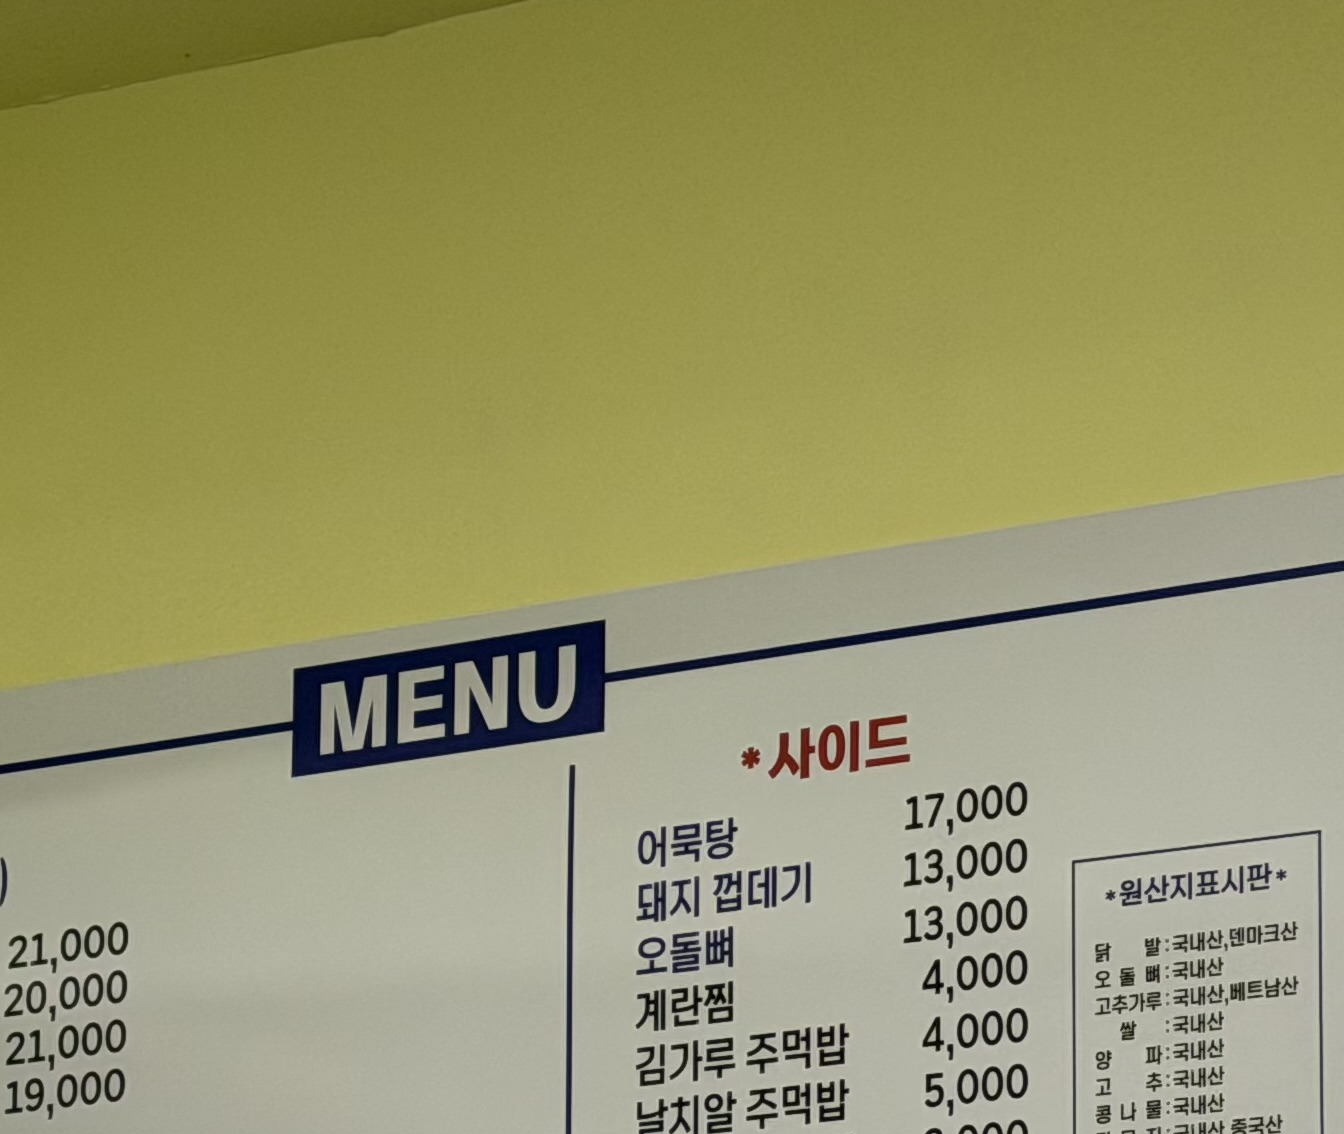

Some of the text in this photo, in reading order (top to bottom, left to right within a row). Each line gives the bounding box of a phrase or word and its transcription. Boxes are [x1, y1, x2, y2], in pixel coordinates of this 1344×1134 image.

[320, 644, 576, 756] MENU
[638, 782, 1027, 867] 어묵탕 17,000
[636, 839, 1027, 922] 돼지 껍데기 13,000
[8, 922, 128, 973] 21,000
[636, 896, 1027, 975] 오돌뼈 13,000
[4, 970, 127, 1021] 20,000
[636, 950, 1027, 1031] 계란찜 4,000
[1096, 992, 1162, 1014] 고추가루
[6, 1019, 126, 1070] 21,000
[636, 1008, 1028, 1086] 김가루 주먹밥 4,000
[1120, 1021, 1137, 1040] 쌀
[5, 1069, 125, 1120] 19,000
[746, 1079, 849, 1129] 주먹밥
[925, 1064, 1028, 1116] 5,000
